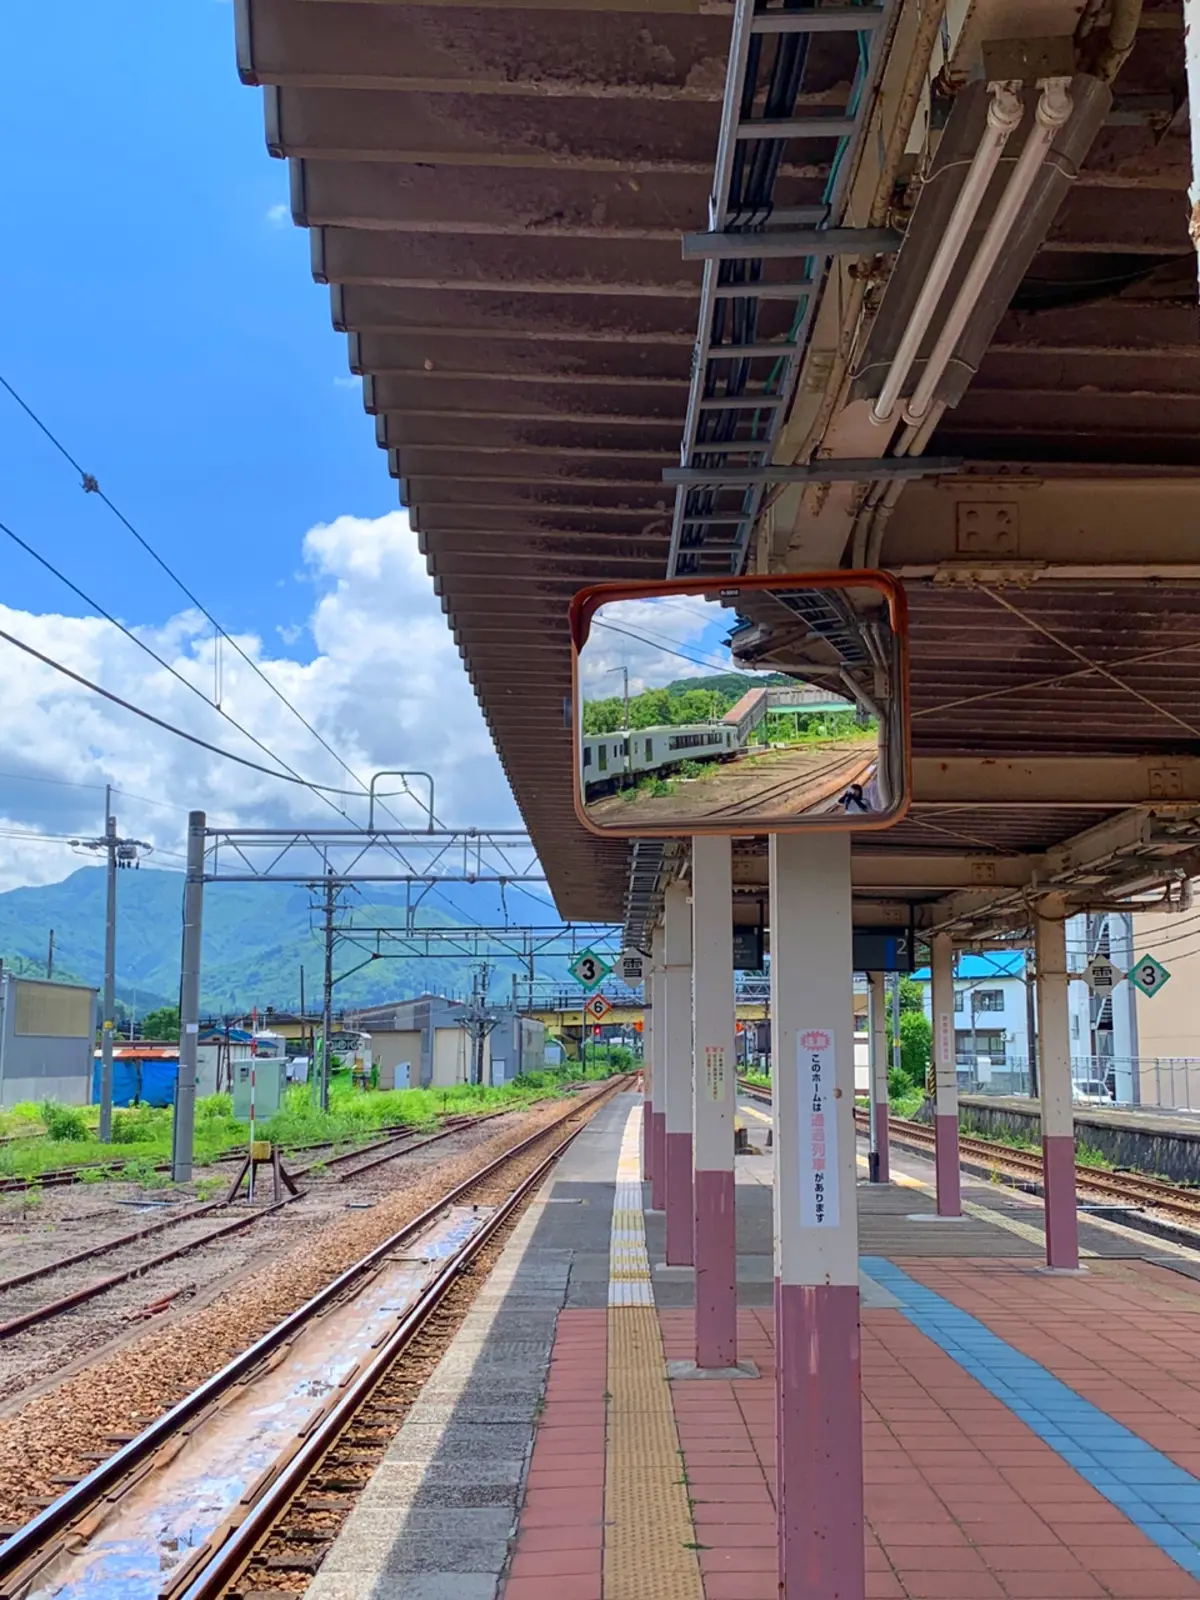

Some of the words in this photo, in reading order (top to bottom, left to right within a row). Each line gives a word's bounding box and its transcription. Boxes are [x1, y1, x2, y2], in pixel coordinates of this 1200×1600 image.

[896, 938, 908, 955] 2
[582, 959, 596, 980] 3
[623, 958, 643, 978] 雪
[1092, 966, 1112, 986] 雪
[1142, 966, 1156, 986] 3
[593, 1001, 603, 1013] 6
